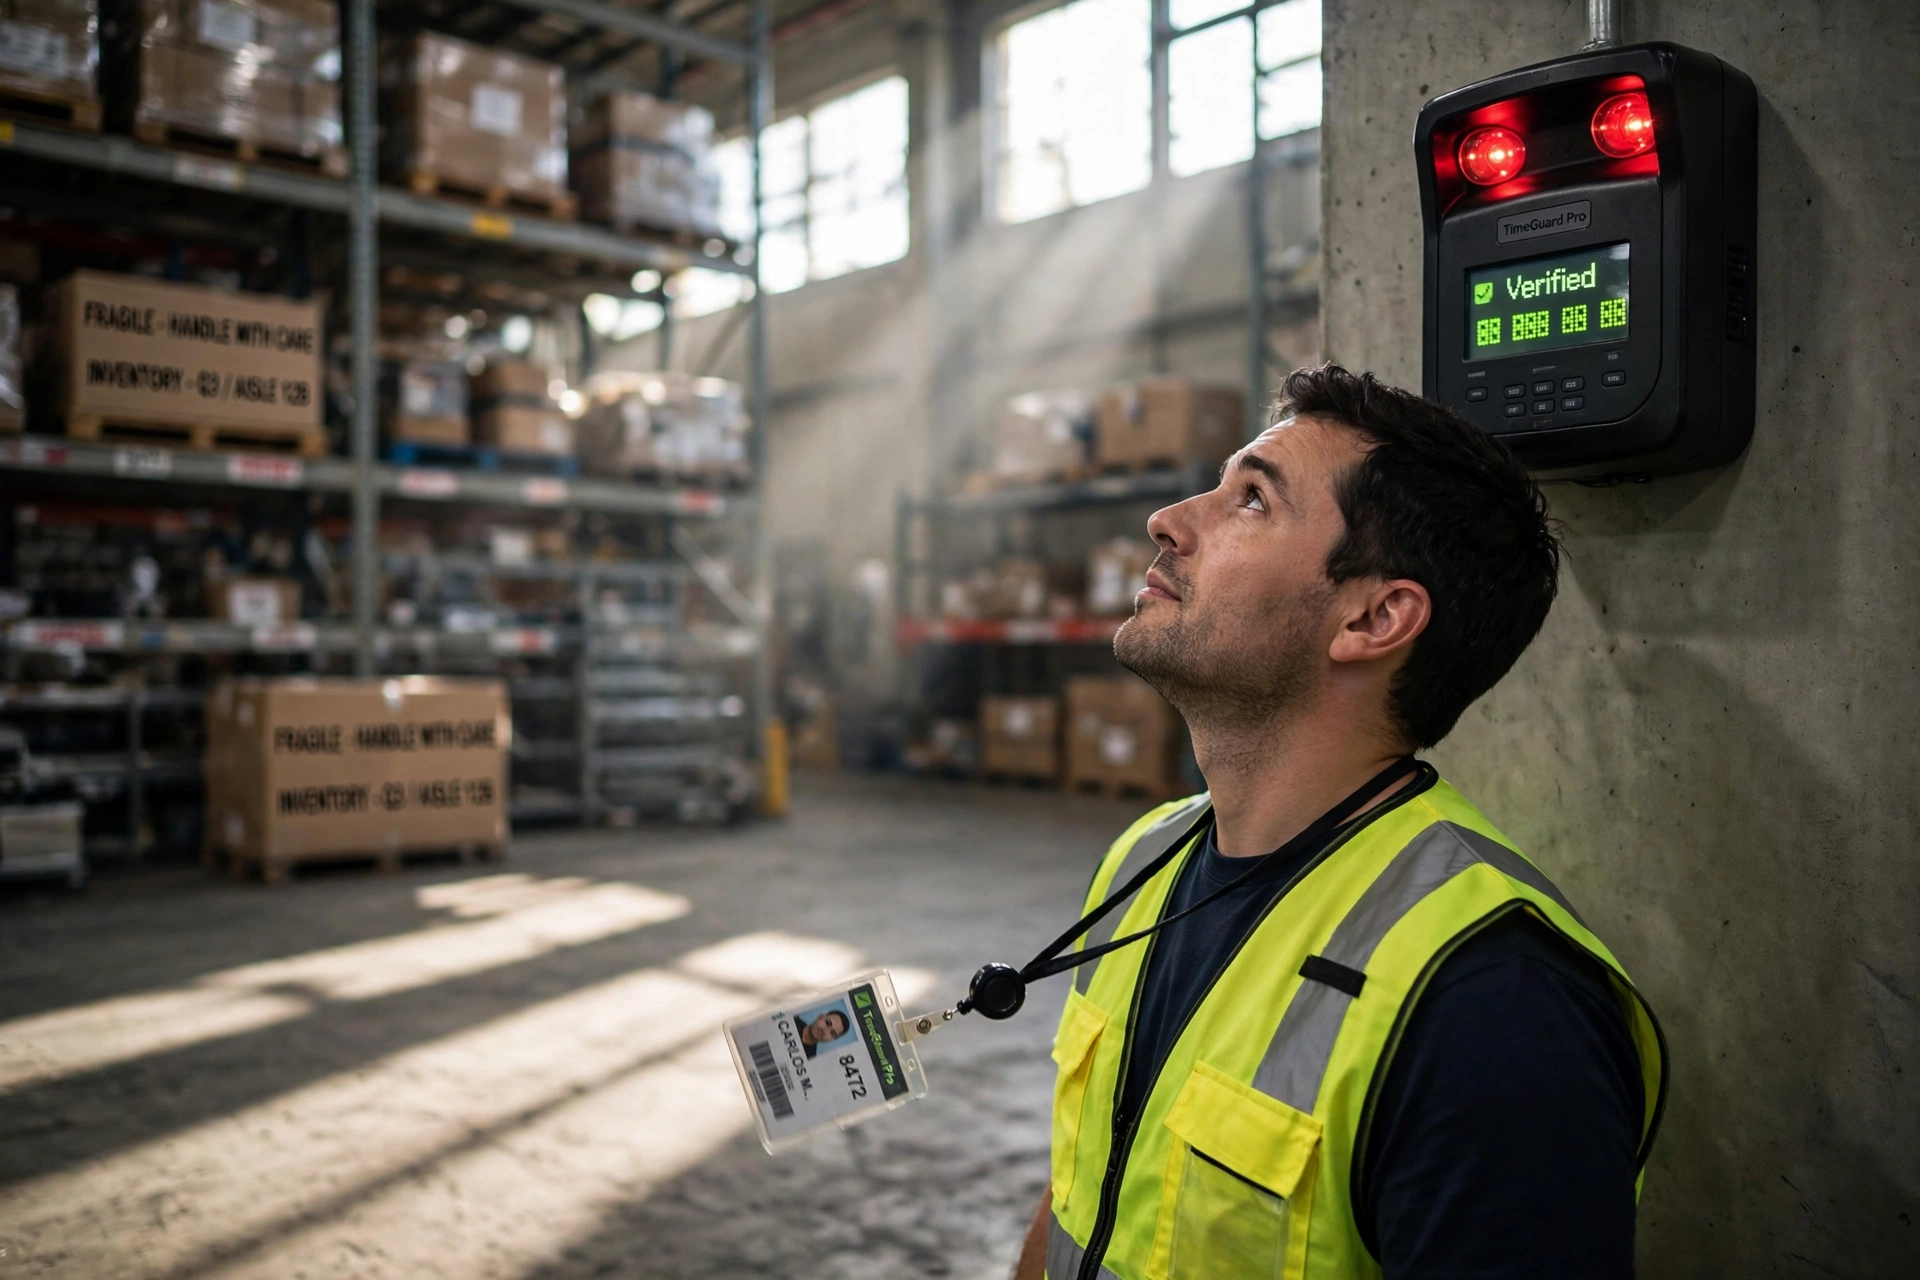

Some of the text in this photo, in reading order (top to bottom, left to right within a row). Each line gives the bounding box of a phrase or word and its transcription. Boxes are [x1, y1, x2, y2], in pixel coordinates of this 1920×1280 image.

[1503, 212, 1587, 236] TimeGuard Pro
[1506, 262, 1596, 300] Verified
[84, 300, 155, 336] FRAGILE
[168, 312, 230, 345] HANDLE
[87, 358, 184, 394] INVENTORY
[274, 723, 342, 754] FRAGILE
[777, 1019, 807, 1076] CARLOS
[838, 1053, 867, 1100] 8472
